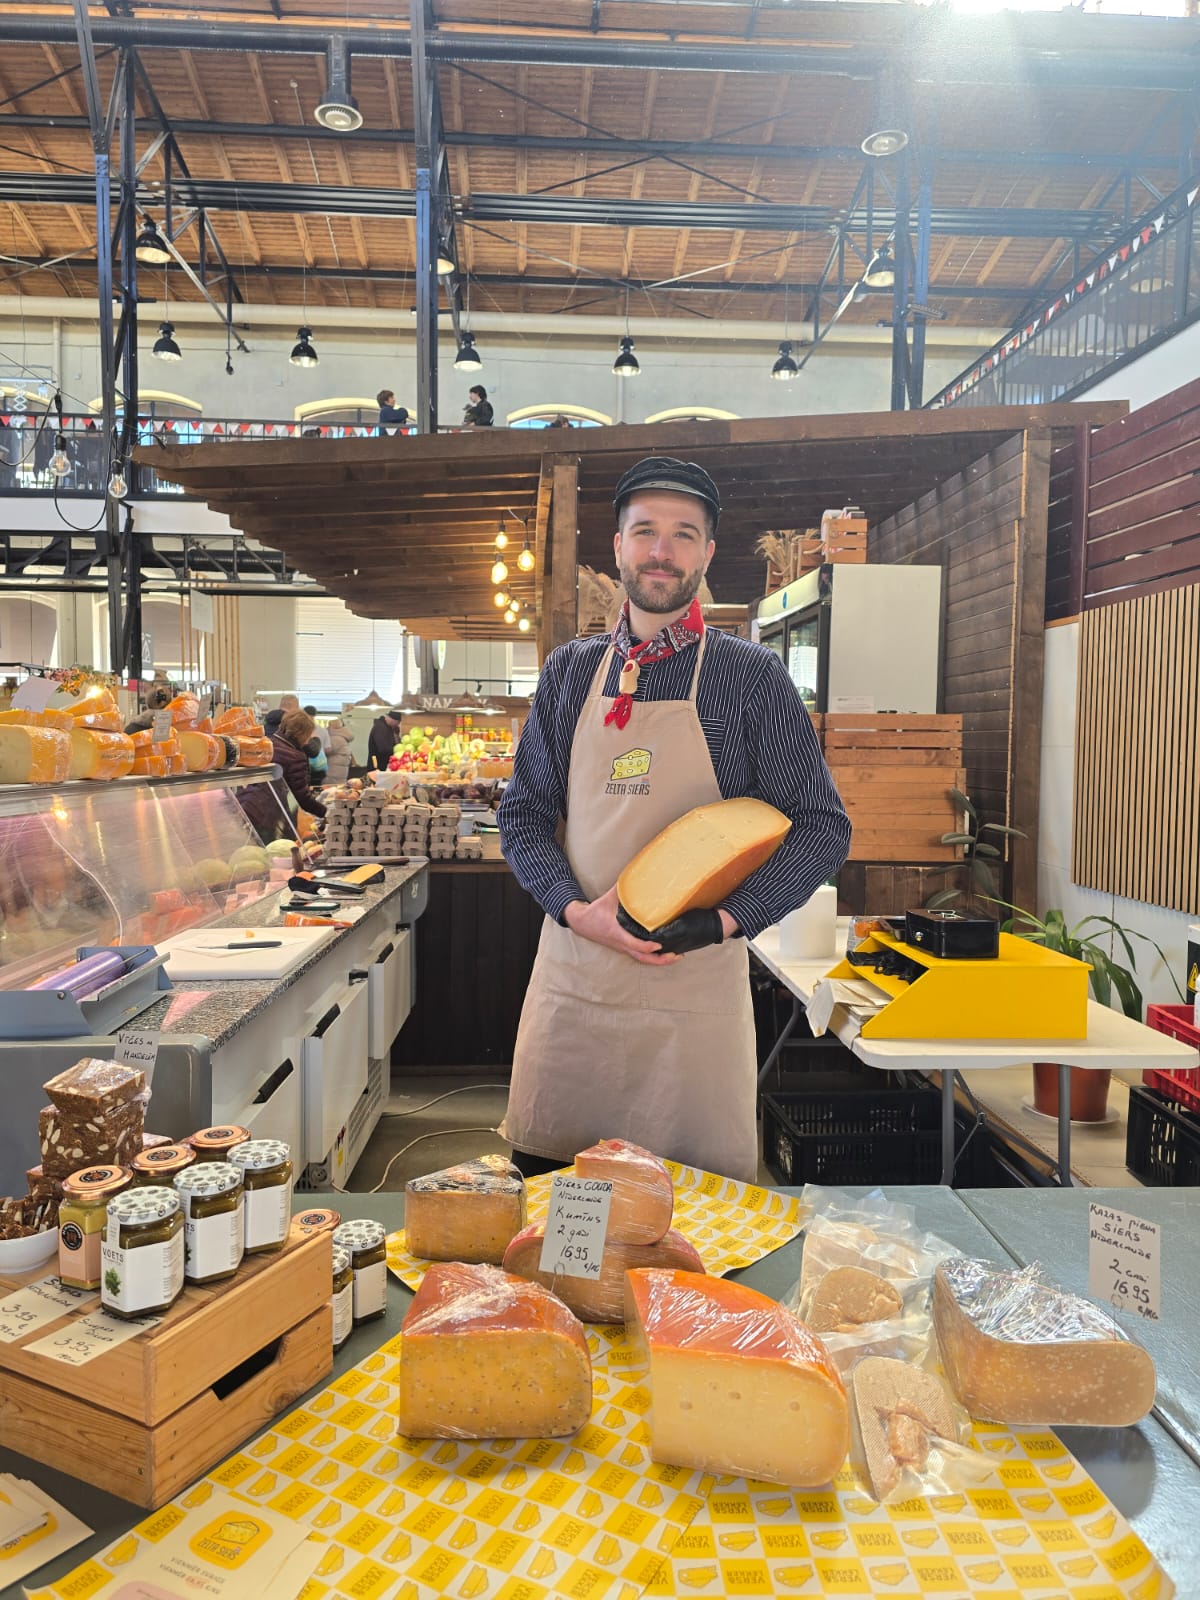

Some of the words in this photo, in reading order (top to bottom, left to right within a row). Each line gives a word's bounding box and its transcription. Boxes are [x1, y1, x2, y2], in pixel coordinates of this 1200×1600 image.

[605, 782, 627, 795] ZELTA
[627, 783, 651, 796] SIERS
[557, 1224, 566, 1236] 2
[1108, 1259, 1122, 1275] 2
